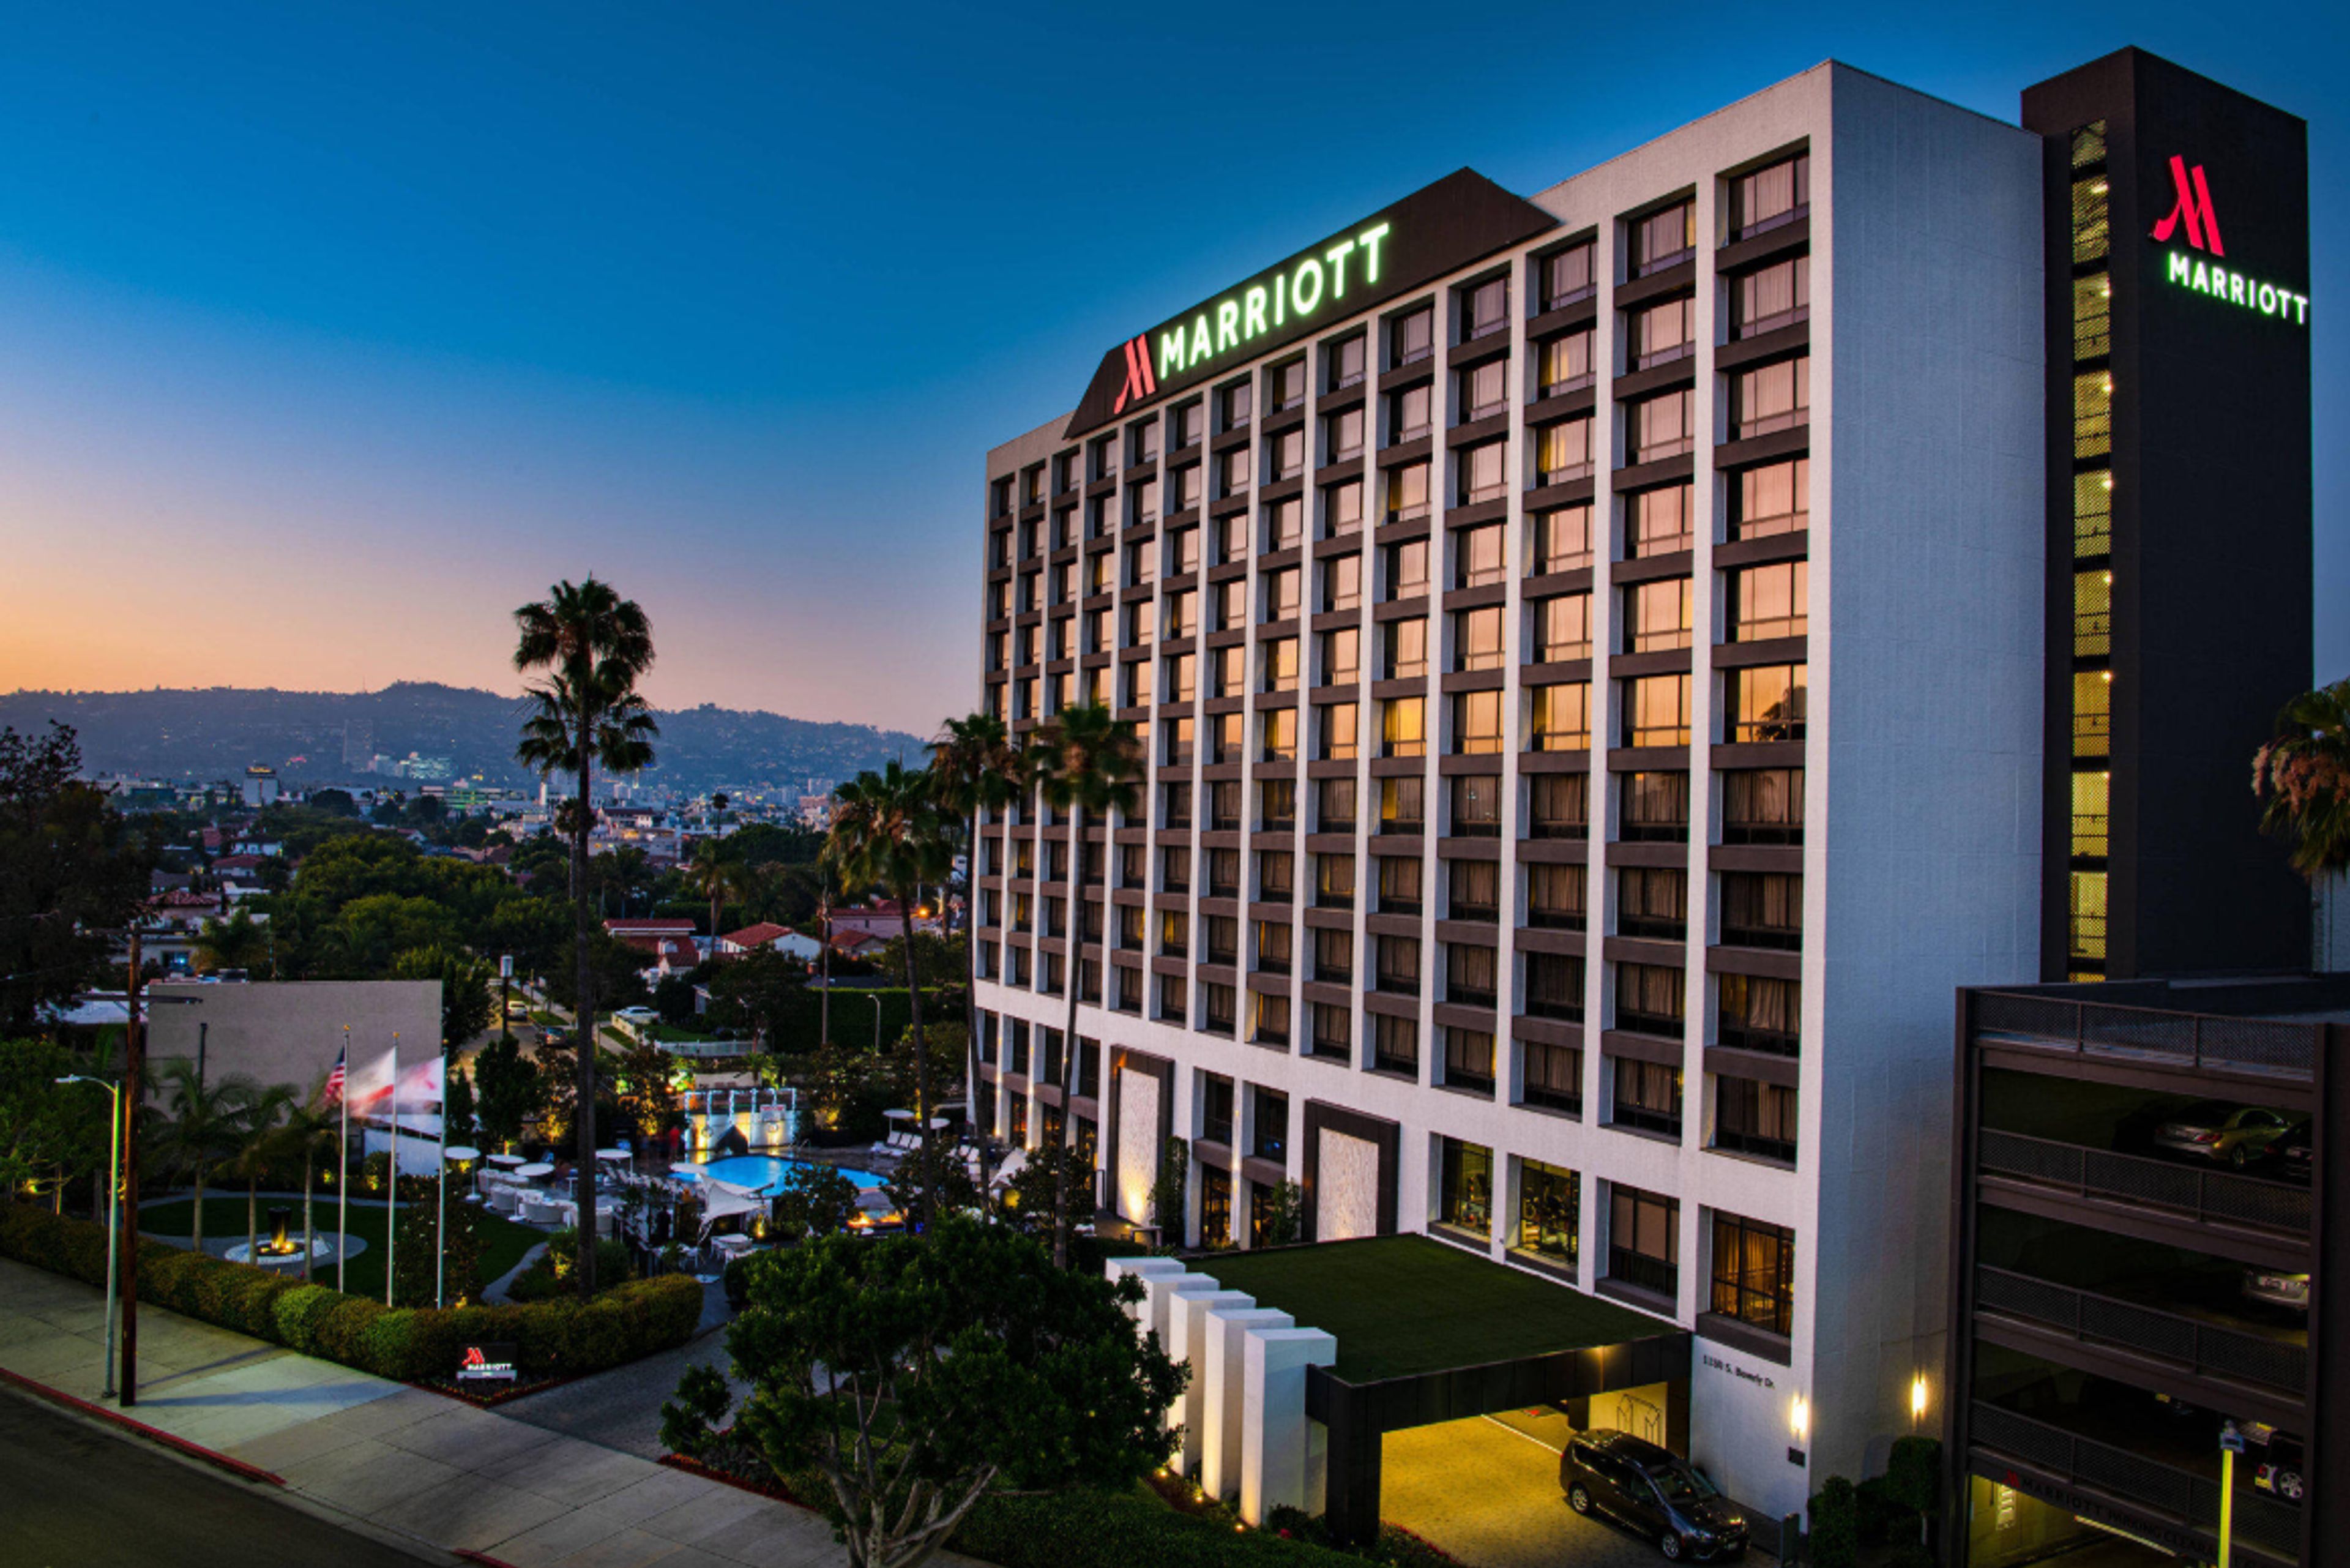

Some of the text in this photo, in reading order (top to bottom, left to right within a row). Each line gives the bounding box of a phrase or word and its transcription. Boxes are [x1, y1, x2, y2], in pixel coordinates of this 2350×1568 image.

[1160, 222, 1390, 381] MARRIOTT
[2168, 251, 2308, 325] MARRIOTT
[2021, 1477, 2102, 1516] MARRIOTT
